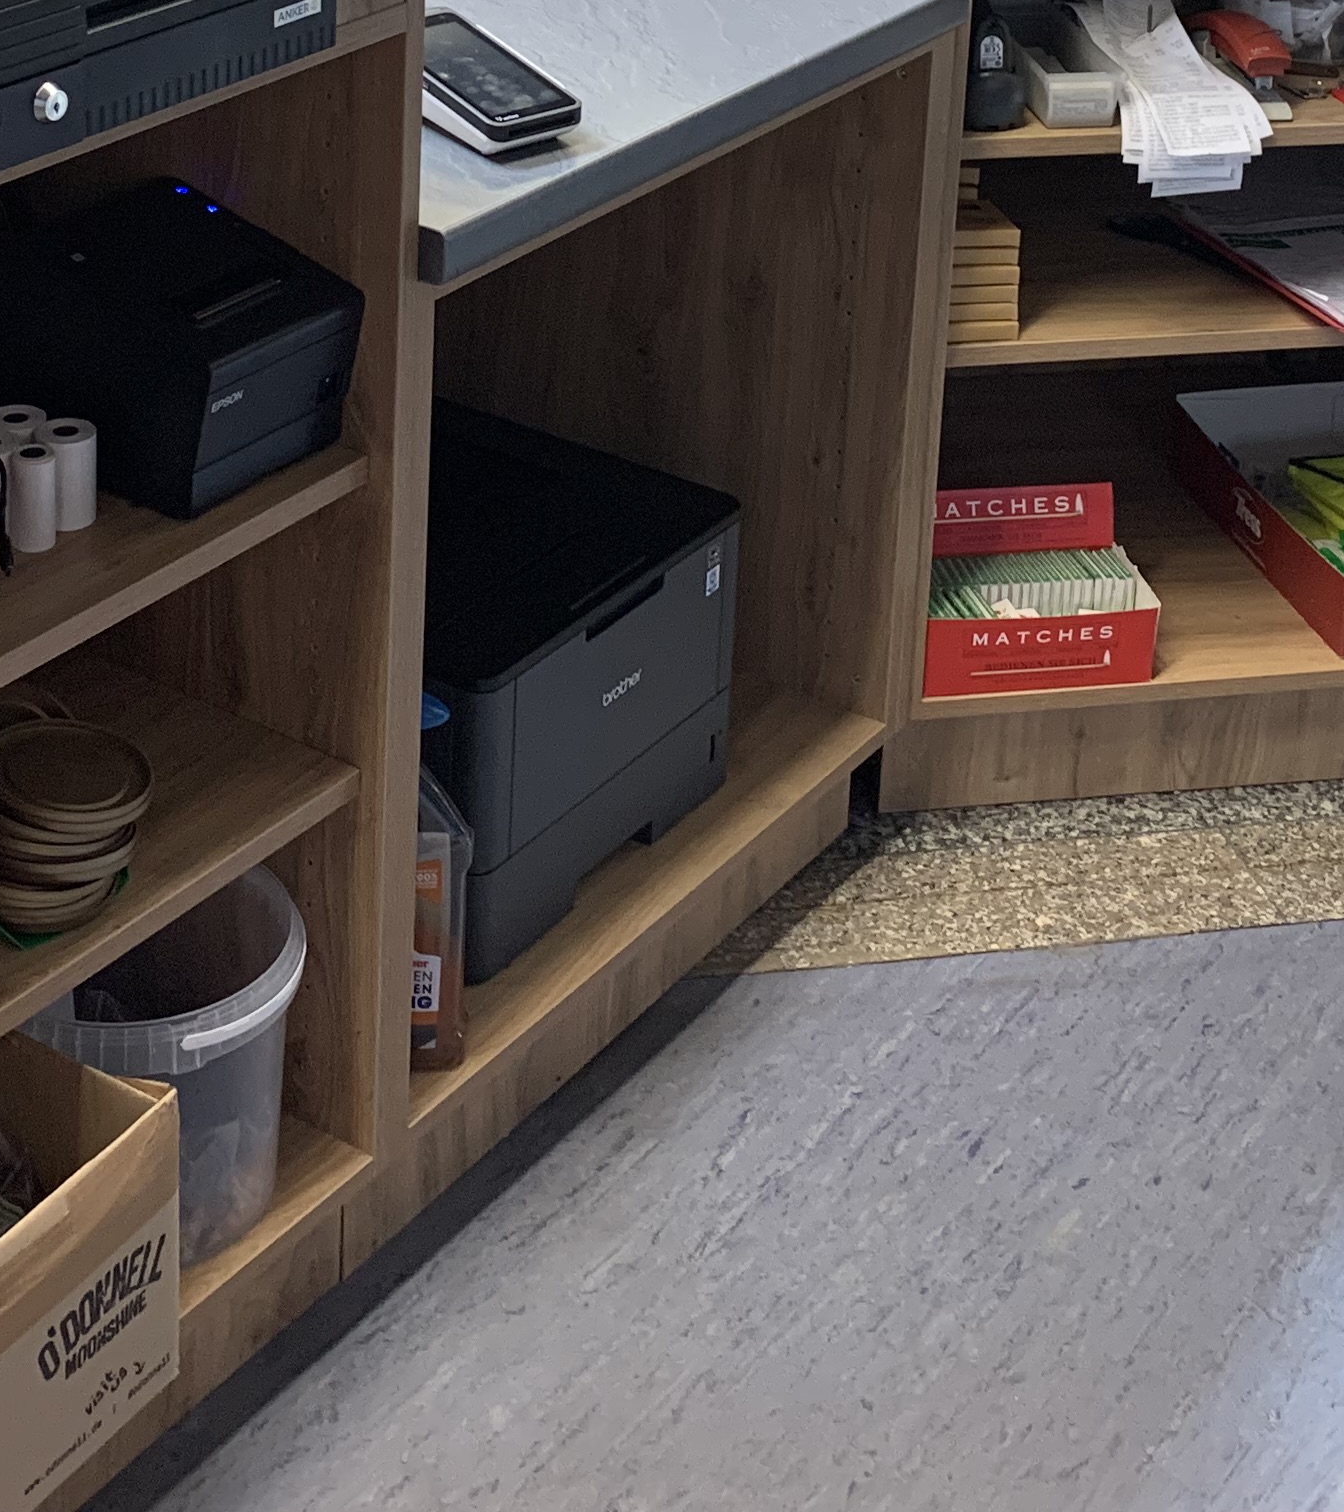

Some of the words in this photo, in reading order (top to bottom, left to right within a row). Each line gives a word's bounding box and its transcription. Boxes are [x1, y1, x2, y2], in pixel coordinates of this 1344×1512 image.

[277, 2, 310, 23] ANKER
[210, 388, 245, 414] EPSON
[972, 625, 1114, 647] MATCHES
[601, 667, 643, 707] brother
[64, 1289, 148, 1380] MOONSHINE
